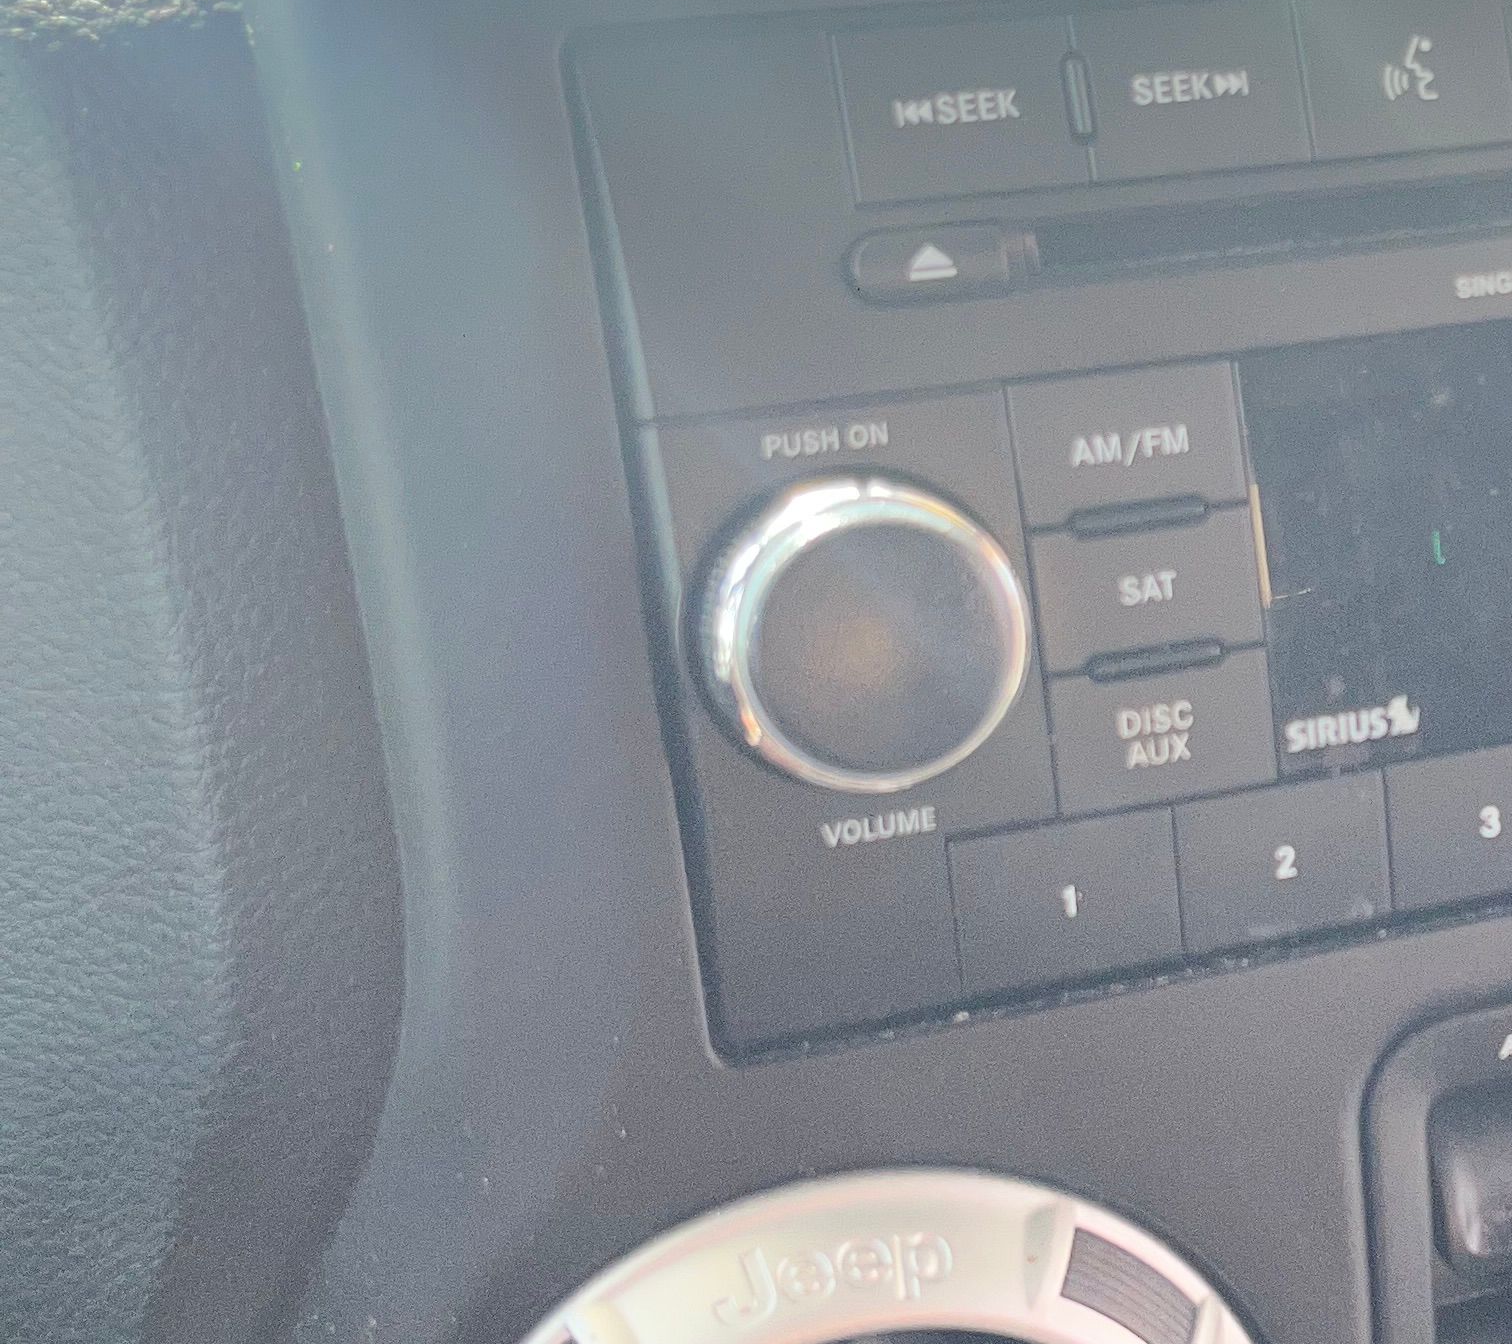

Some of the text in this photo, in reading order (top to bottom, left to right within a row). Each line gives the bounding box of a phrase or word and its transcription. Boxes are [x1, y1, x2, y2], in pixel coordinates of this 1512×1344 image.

[1132, 72, 1213, 105] SEEK
[935, 89, 1020, 125] SEEK
[761, 422, 889, 459] PUSH ON
[1071, 424, 1189, 466] AM/FM
[1119, 570, 1177, 606] SAT
[1117, 701, 1194, 739] DISC
[1285, 704, 1391, 753] SIRIUS
[1125, 736, 1191, 769] AUX
[821, 805, 936, 847] VOLUME
[1480, 805, 1501, 838] 3
[1275, 845, 1297, 879] 2
[1062, 885, 1077, 917] 1
[710, 1230, 954, 1328] Jeep
